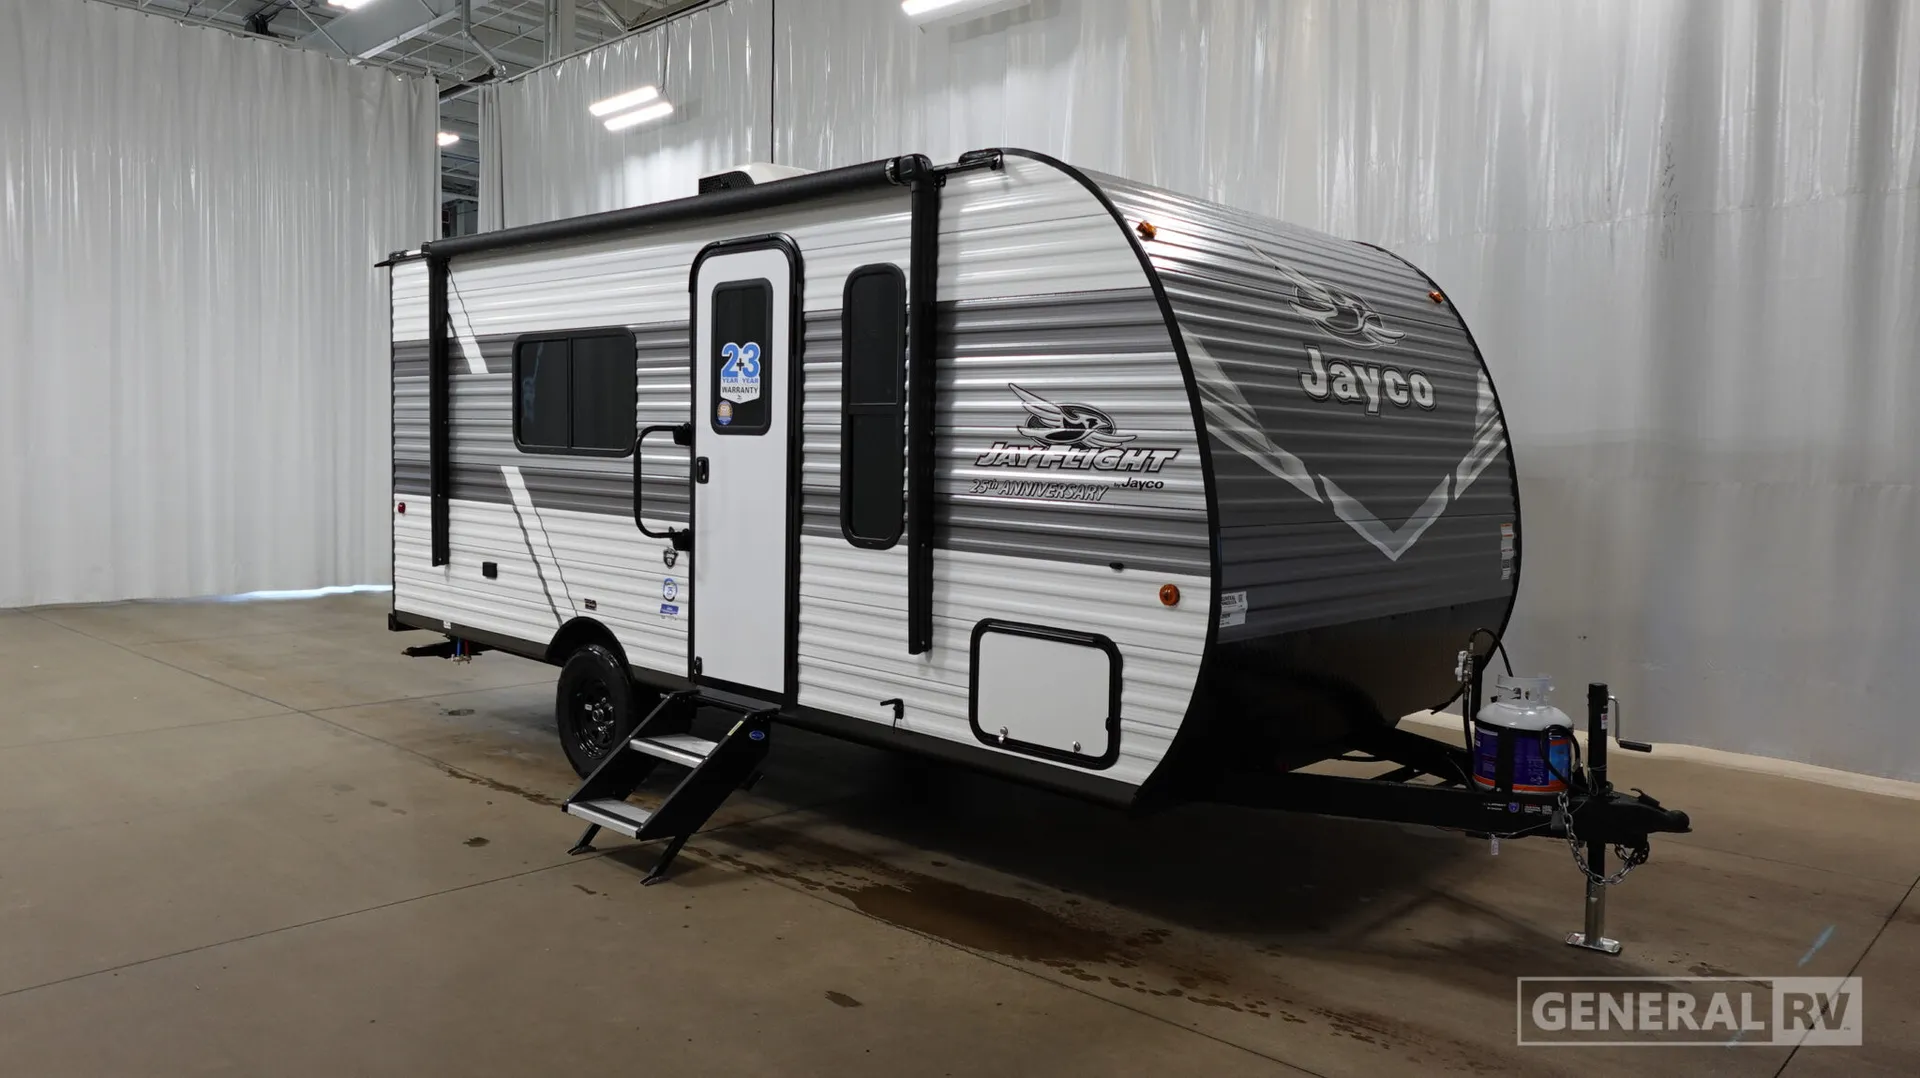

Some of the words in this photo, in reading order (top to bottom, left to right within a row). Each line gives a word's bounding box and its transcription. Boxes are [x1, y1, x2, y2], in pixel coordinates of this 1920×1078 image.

[1299, 345, 1436, 416] Jayco
[722, 386, 758, 394] WARRANTY
[969, 479, 998, 494] 25th
[998, 480, 1109, 501] ANNIVERSARY
[1121, 477, 1164, 491] Jayco
